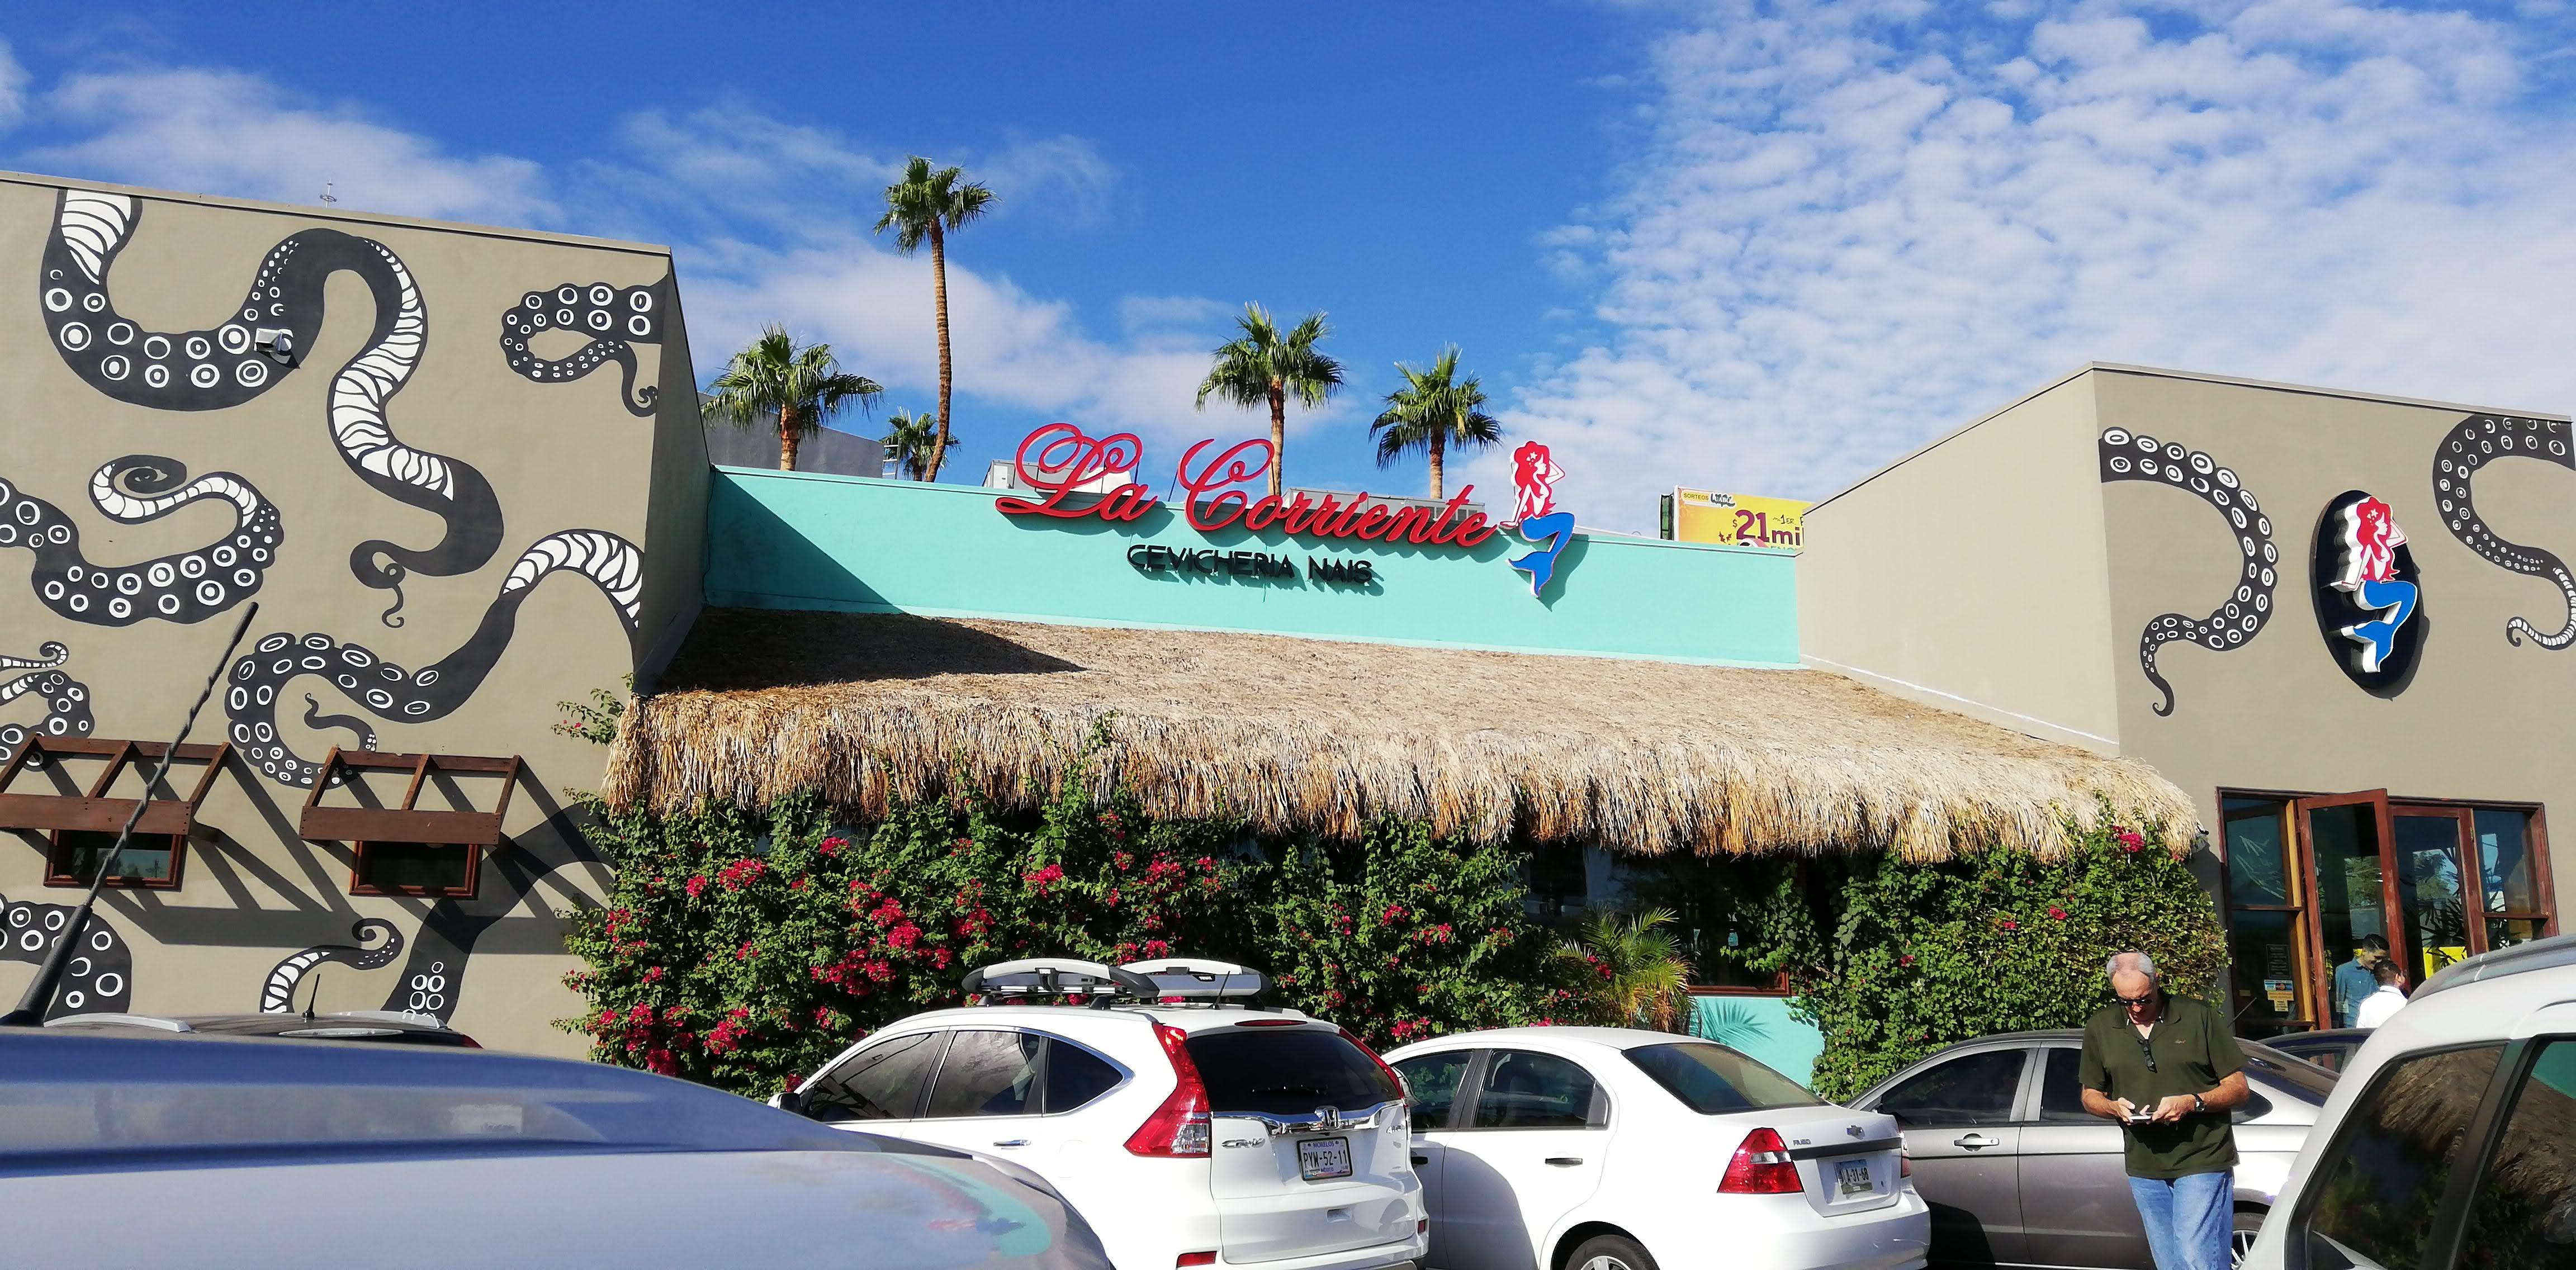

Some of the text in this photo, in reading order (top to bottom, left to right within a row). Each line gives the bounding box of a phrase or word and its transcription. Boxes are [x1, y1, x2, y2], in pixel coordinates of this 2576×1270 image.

[995, 423, 1498, 548] La Corriente
[1127, 544, 1373, 583] CEVICHERIA NAIS
[1303, 1149, 1347, 1168] PYW-52-11
[1313, 1140, 1334, 1149] MORELOS
